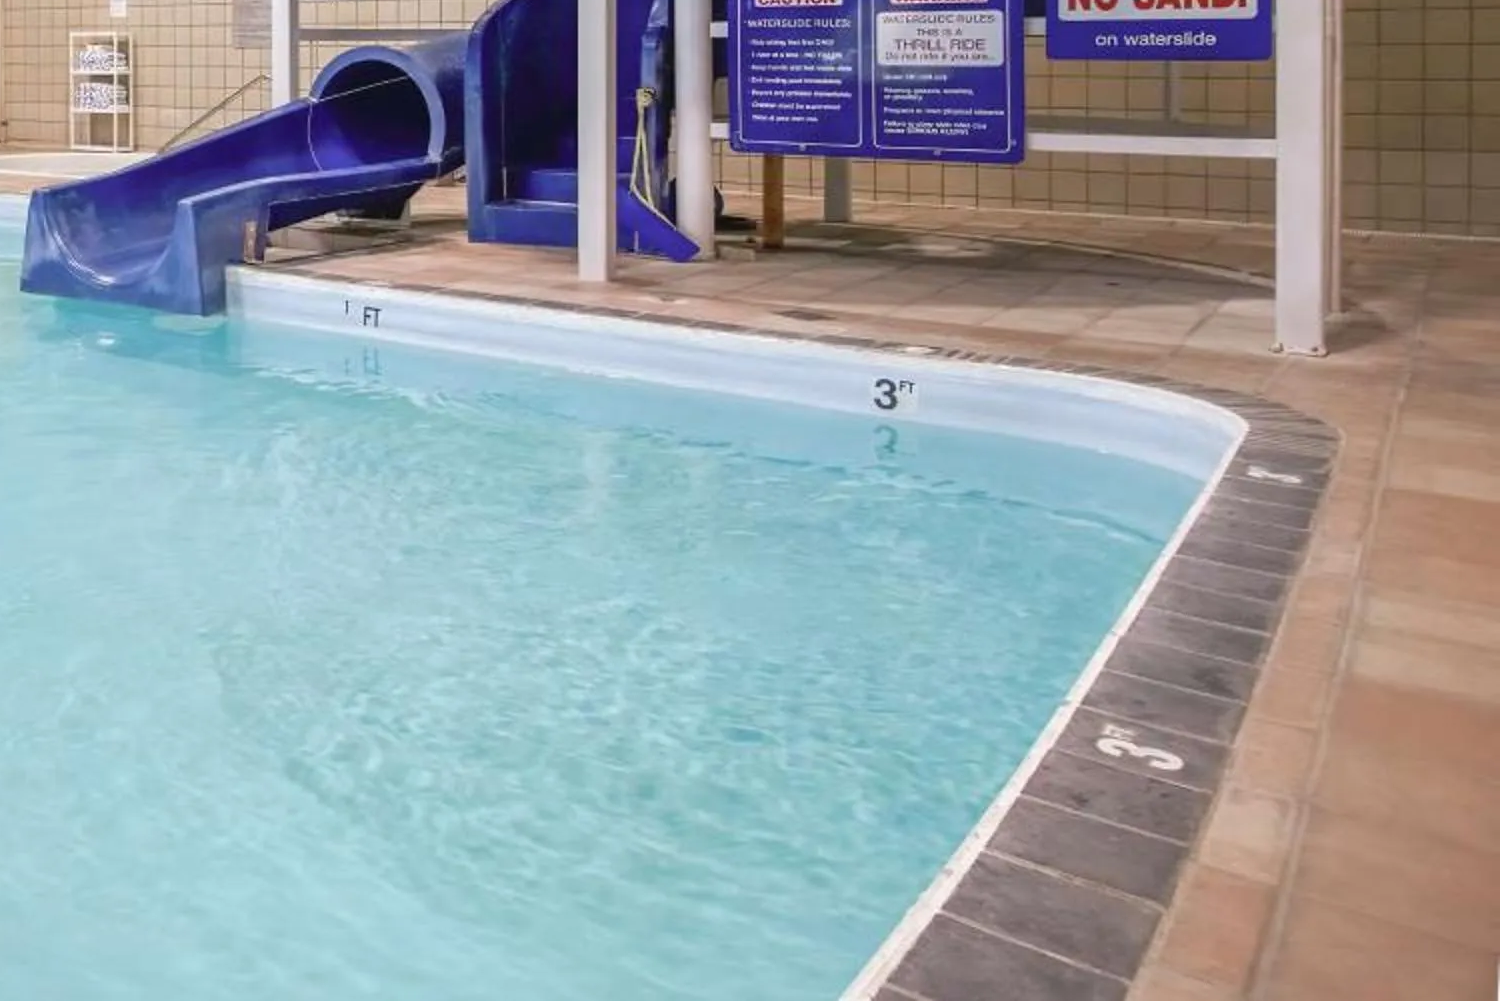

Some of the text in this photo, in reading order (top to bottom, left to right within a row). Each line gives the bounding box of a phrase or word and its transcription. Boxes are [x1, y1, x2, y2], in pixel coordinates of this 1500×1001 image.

[916, 28, 939, 36] THIS
[1095, 31, 1218, 47] on waterslide
[894, 39, 987, 51] THRILL RIDE
[363, 306, 382, 328] FT
[873, 378, 898, 410] 3
